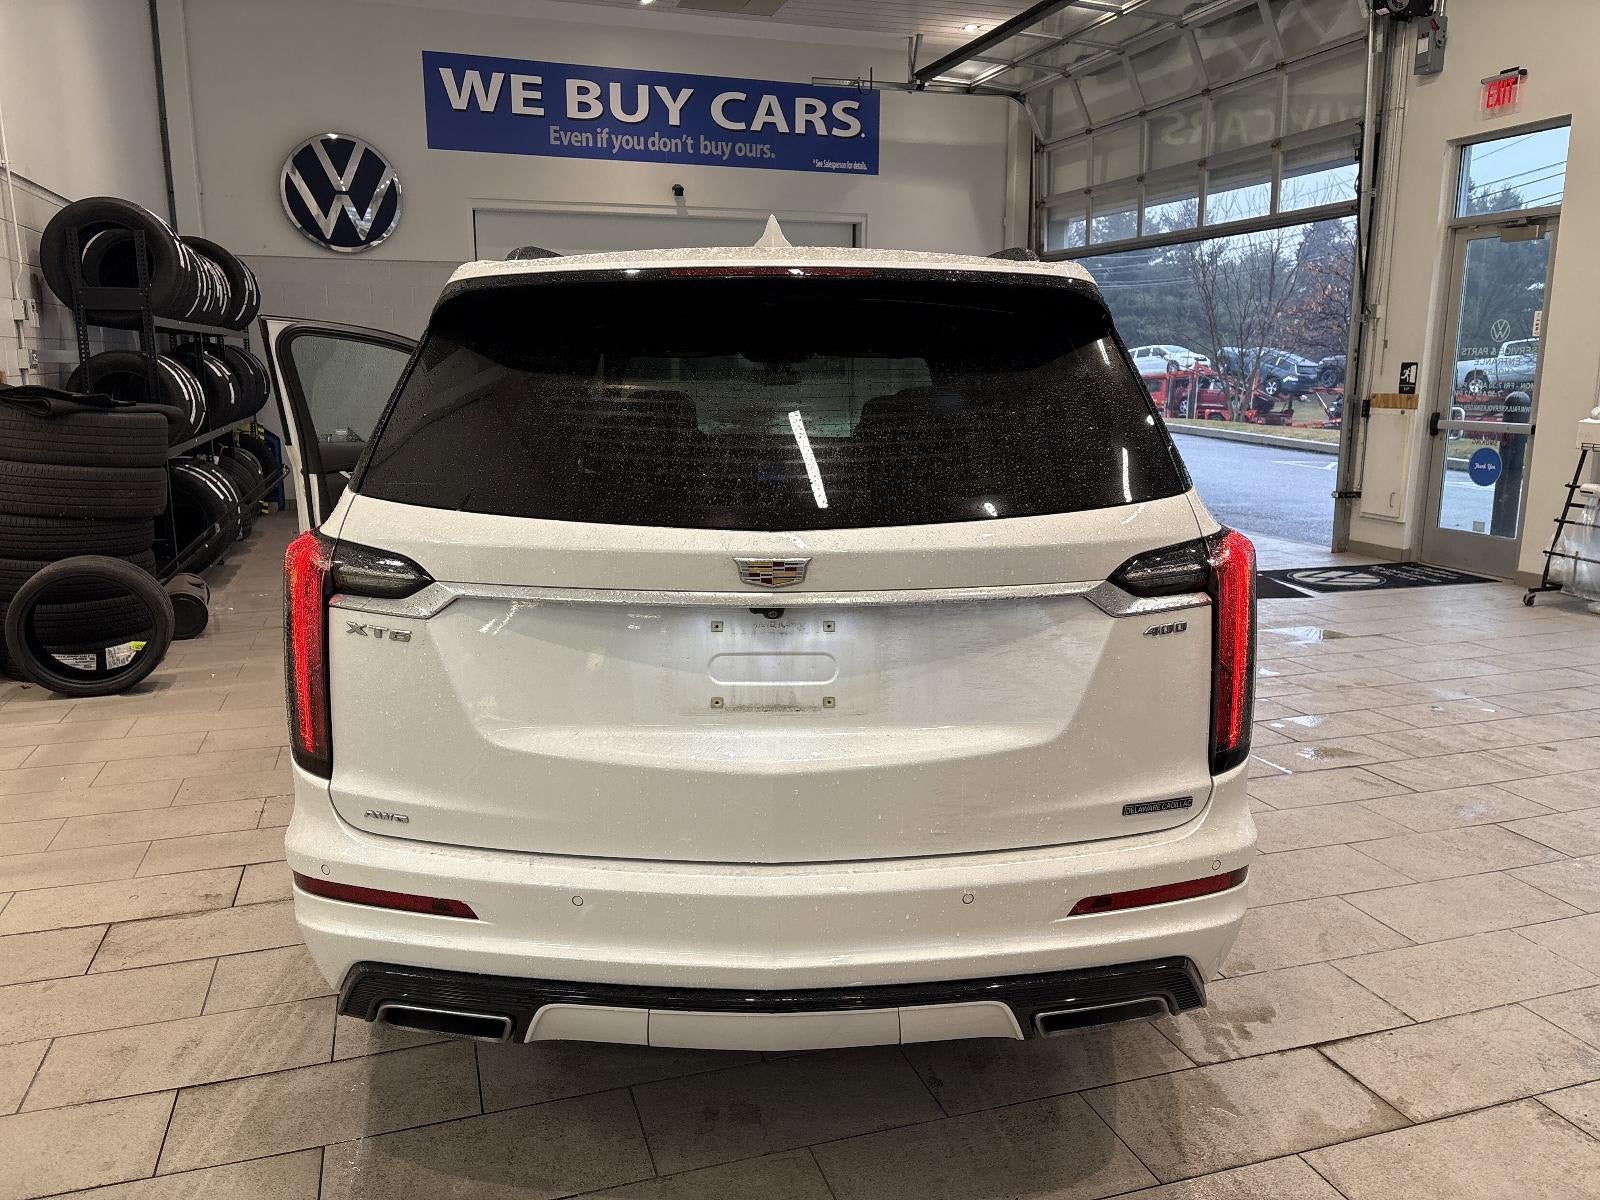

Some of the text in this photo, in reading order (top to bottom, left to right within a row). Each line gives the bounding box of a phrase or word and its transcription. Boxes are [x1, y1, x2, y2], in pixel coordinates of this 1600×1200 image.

[438, 67, 545, 117] WE
[565, 78, 695, 127] BUY
[1486, 78, 1518, 109] EXIT
[549, 125, 776, 160] Even if you don't buy ours.
[1474, 462, 1496, 471] Thank You
[346, 620, 412, 642] XT6
[1143, 621, 1187, 636] 400
[1125, 799, 1192, 815] DELAWARE CADILLAC
